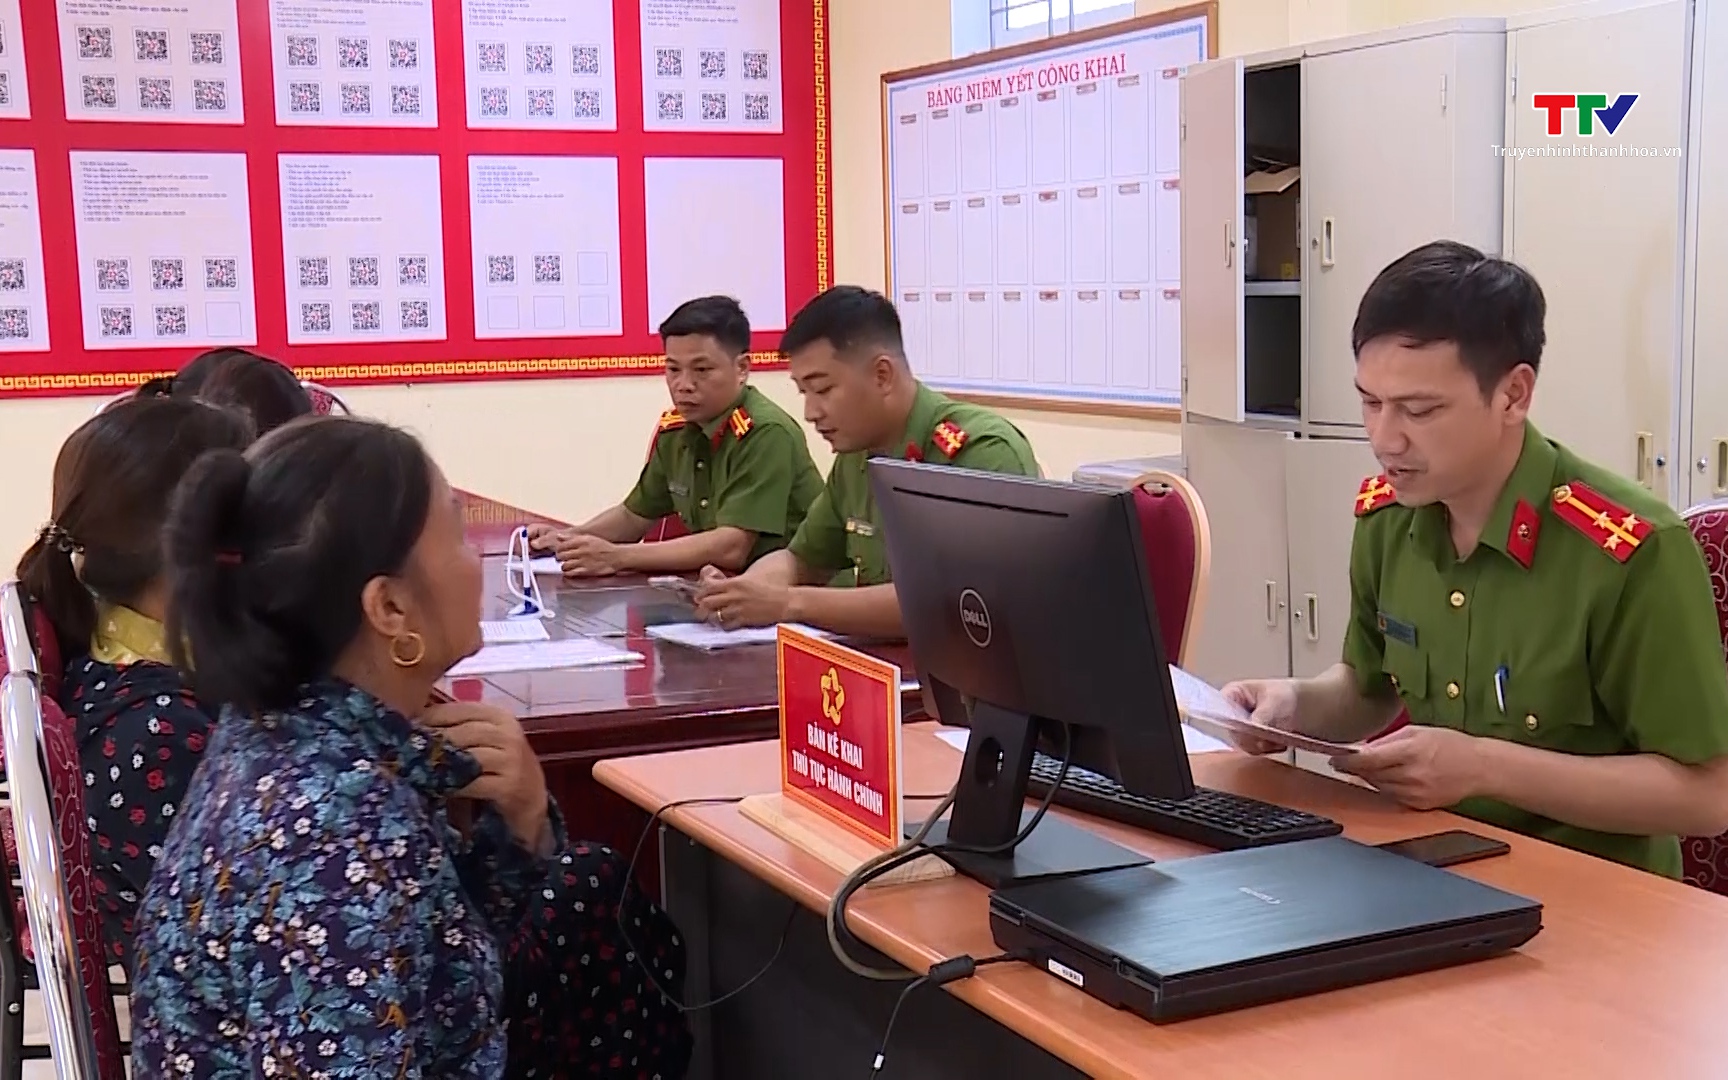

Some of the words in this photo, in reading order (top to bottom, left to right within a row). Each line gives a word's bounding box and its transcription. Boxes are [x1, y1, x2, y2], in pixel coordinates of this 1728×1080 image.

[926, 83, 963, 108] BẢNG
[1006, 66, 1034, 94] YẾT
[1037, 63, 1080, 88] CÔNG
[1084, 53, 1126, 79] KHAI
[963, 608, 988, 628] DELL
[840, 739, 863, 770] KHAI
[792, 748, 809, 777] THỦ
[809, 758, 826, 788] TỤC
[827, 765, 853, 801] HÀNH
[853, 781, 883, 816] CHÍNH
